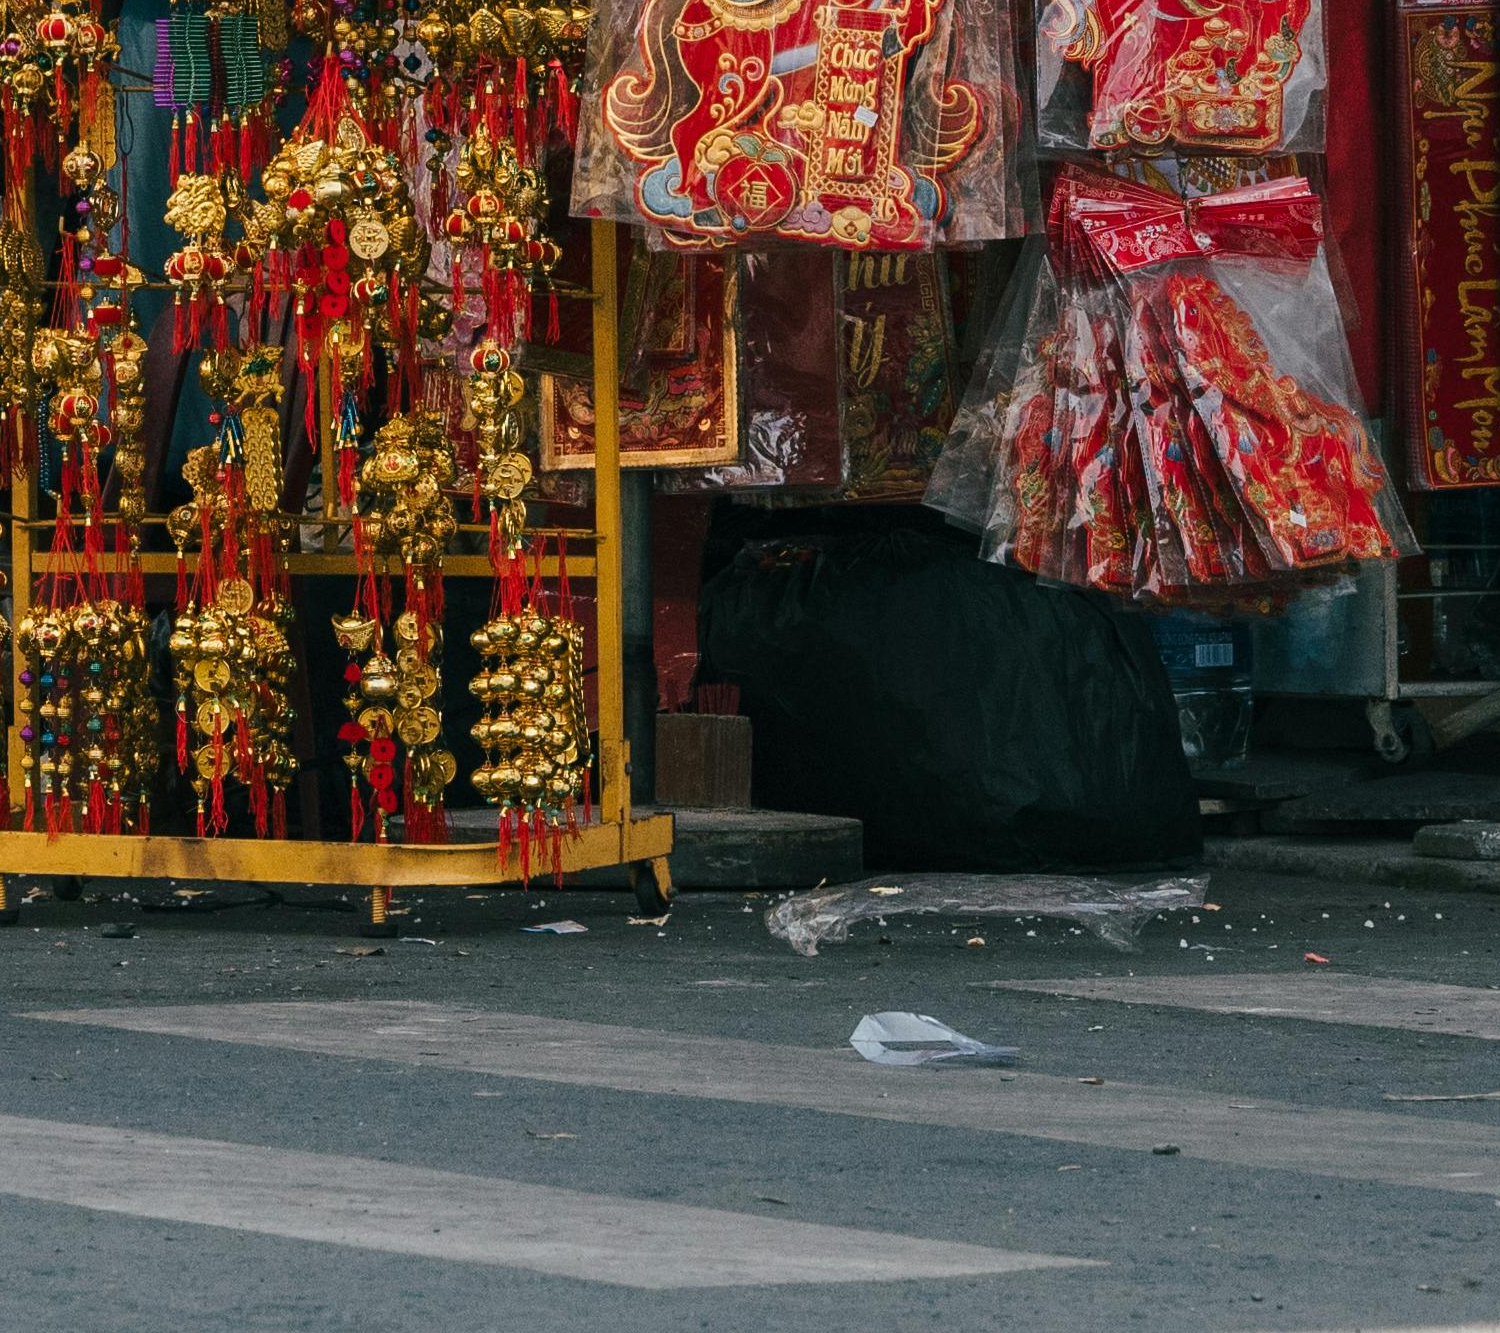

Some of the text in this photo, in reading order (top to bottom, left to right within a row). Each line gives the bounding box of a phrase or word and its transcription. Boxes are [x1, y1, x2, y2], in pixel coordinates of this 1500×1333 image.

[831, 40, 879, 70] Chúc
[829, 75, 878, 111] Mừng
[825, 146, 864, 176] Mới
[739, 179, 769, 210] 福
